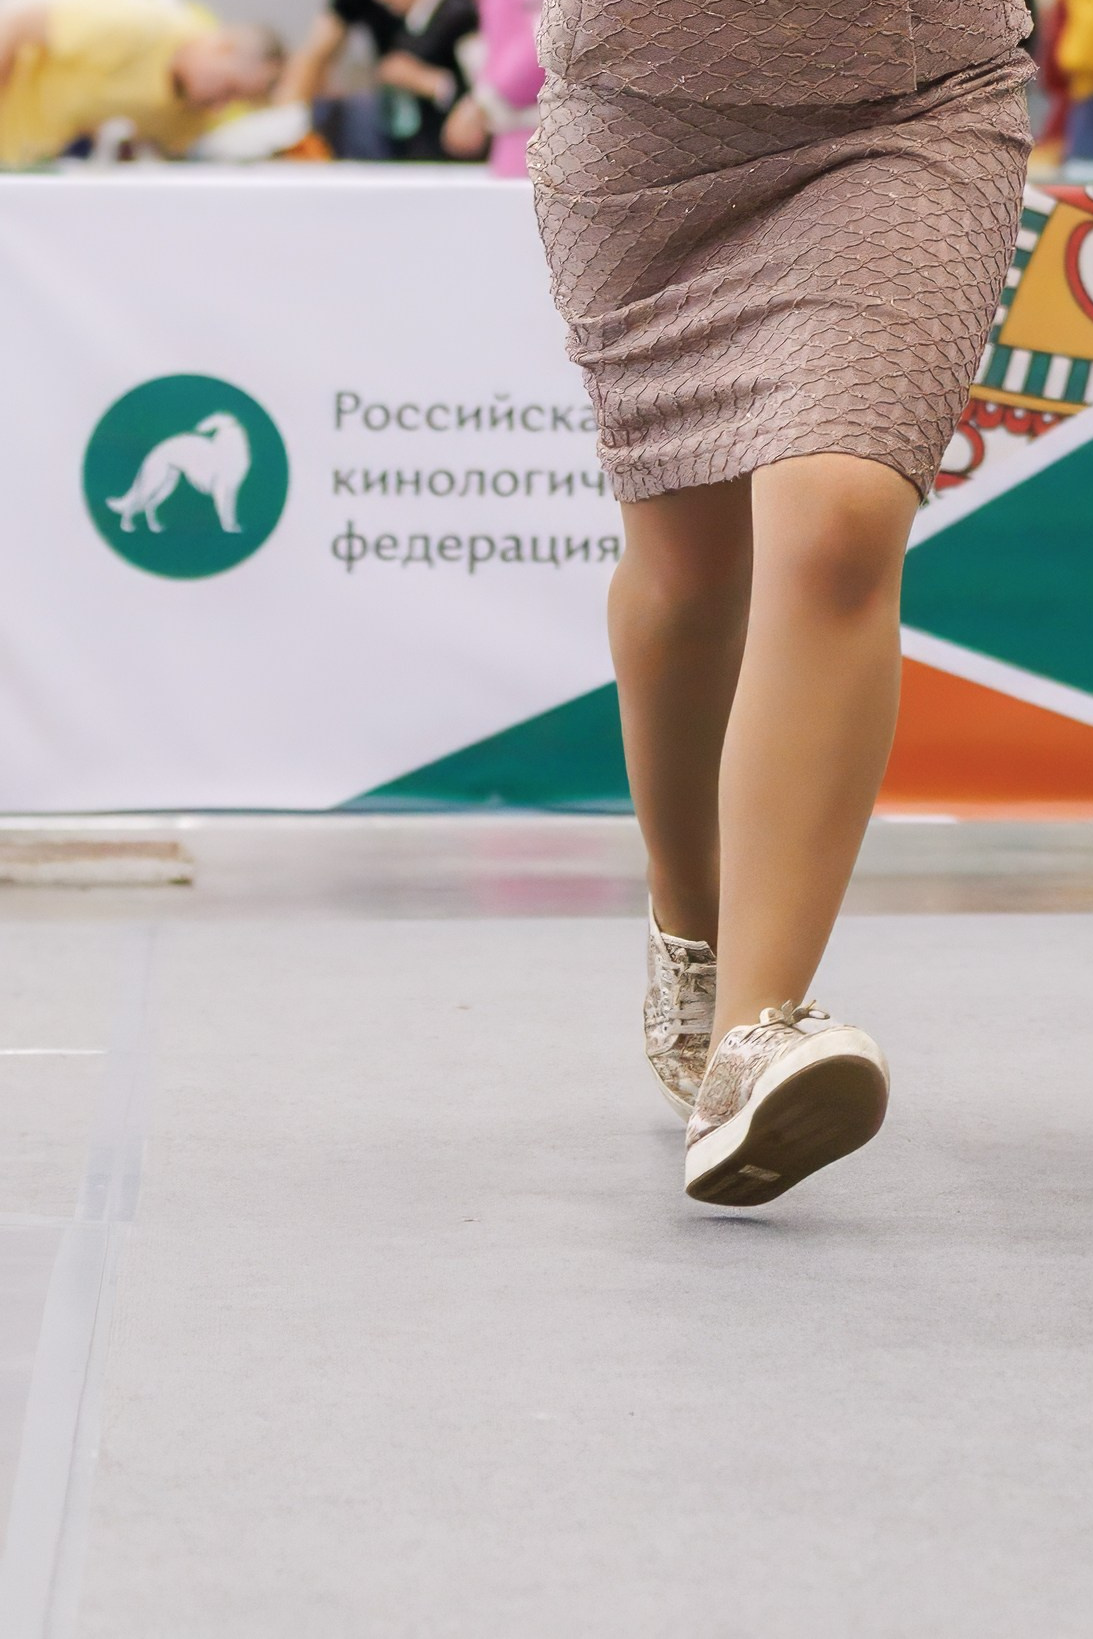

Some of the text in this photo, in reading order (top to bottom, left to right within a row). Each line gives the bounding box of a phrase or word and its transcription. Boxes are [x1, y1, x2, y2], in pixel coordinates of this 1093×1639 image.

[332, 391, 597, 433] Российска
[331, 469, 606, 498] кинологич
[331, 520, 622, 573] федерация
